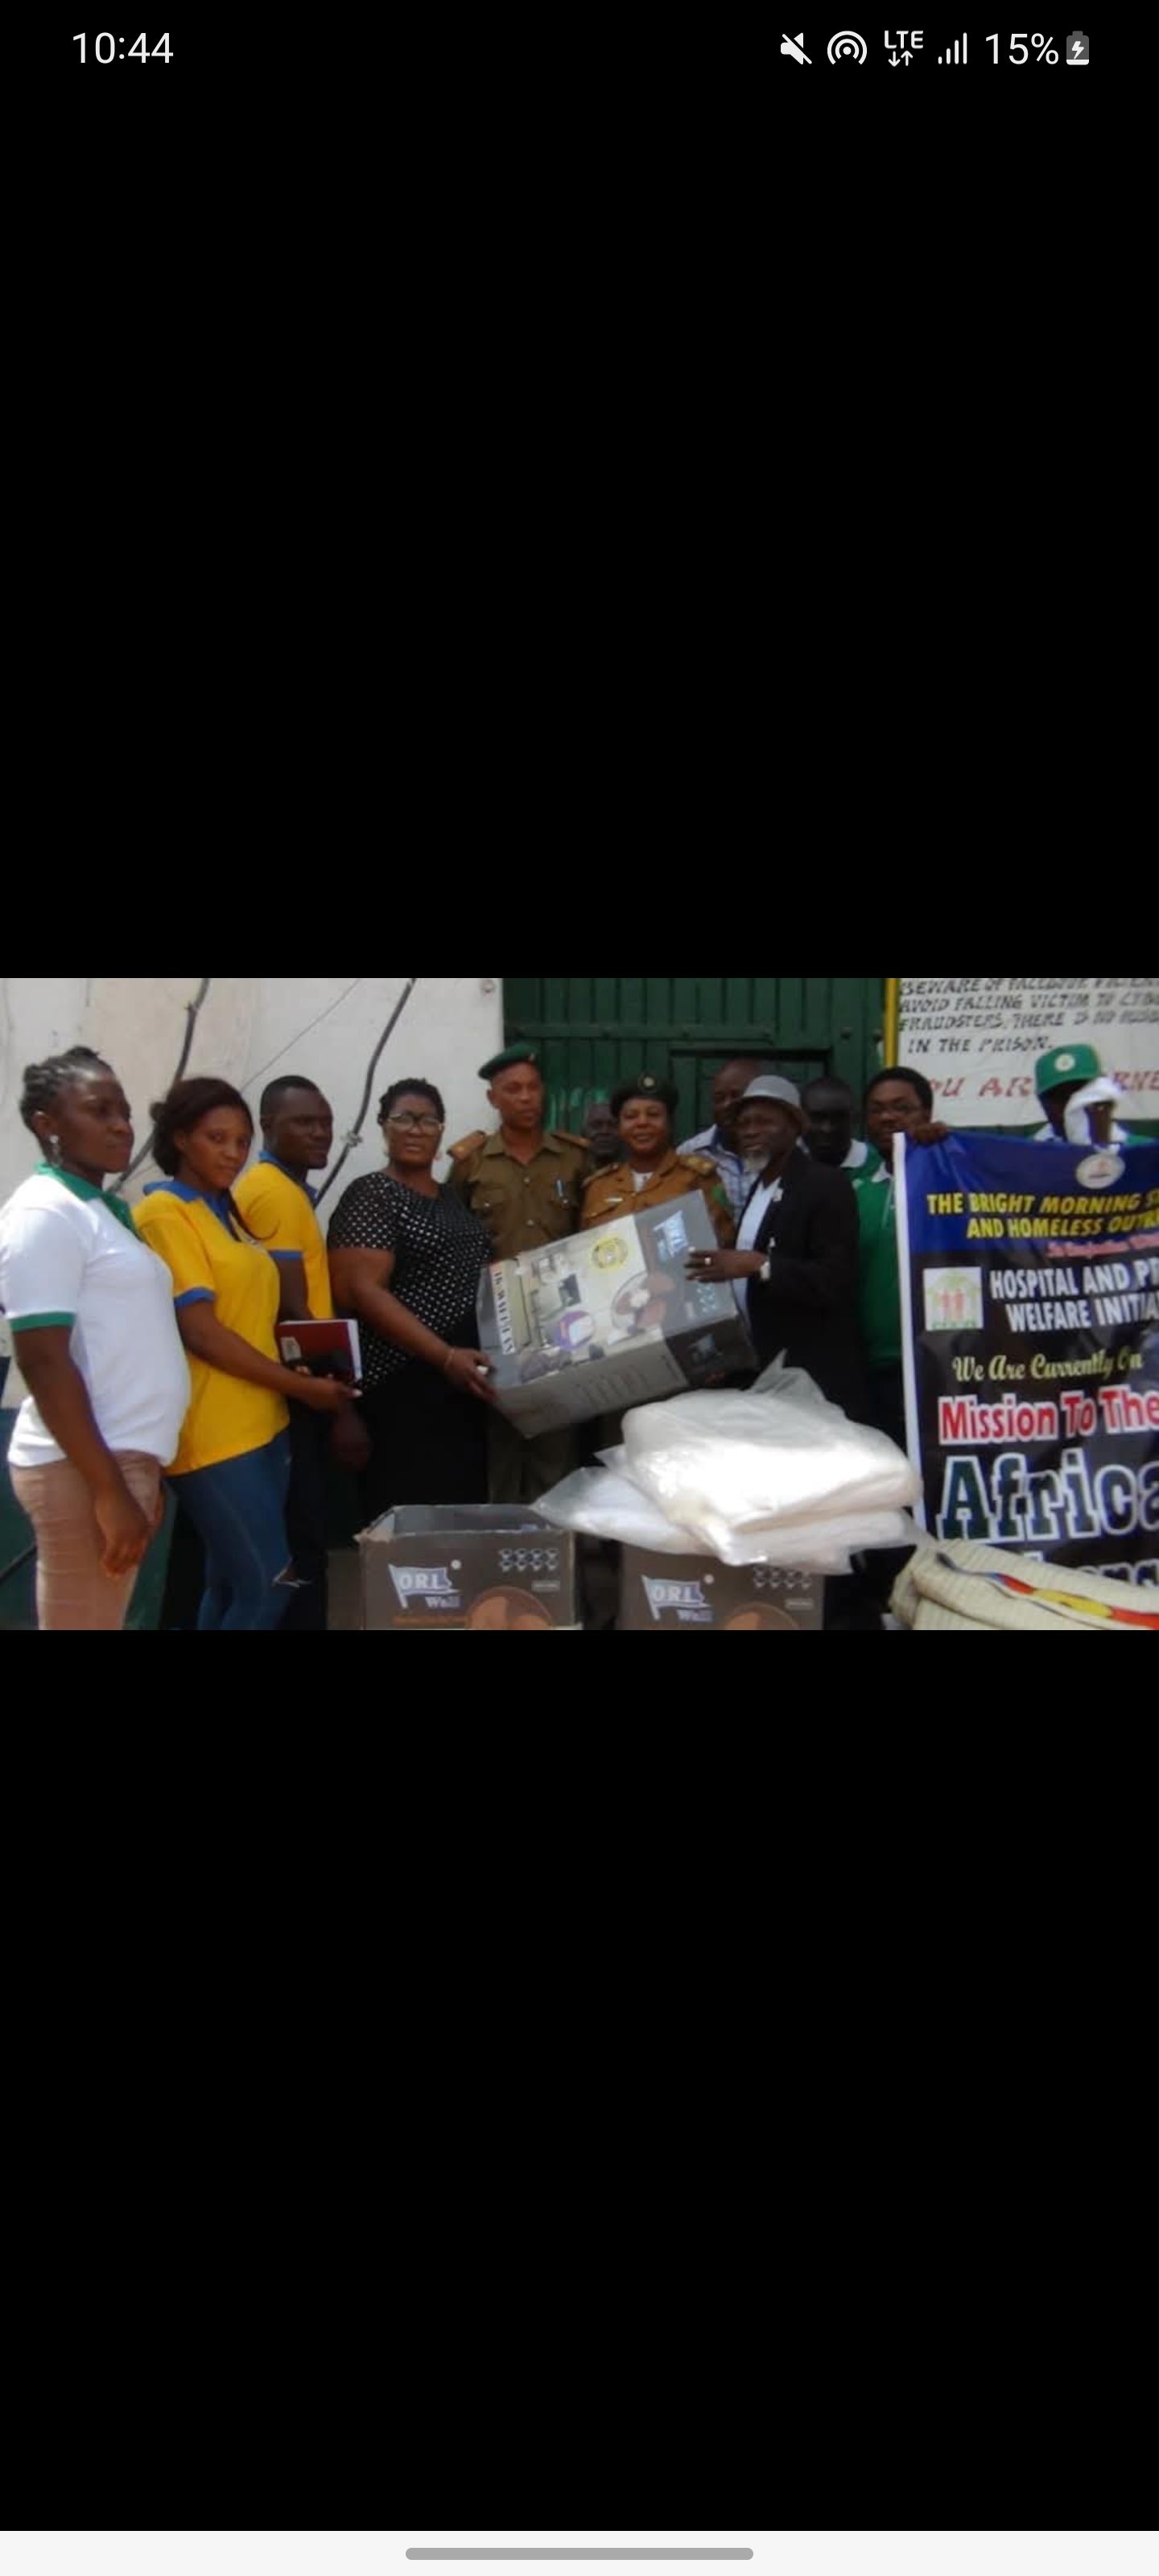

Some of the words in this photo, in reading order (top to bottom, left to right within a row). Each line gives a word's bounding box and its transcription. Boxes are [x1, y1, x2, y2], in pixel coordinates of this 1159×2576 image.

[899, 997, 951, 1013] AVOID
[954, 993, 1024, 1011] FALLING
[1013, 1012, 1065, 1030] THERE
[908, 1038, 932, 1054] IN
[938, 1038, 971, 1053] THE
[926, 1193, 964, 1215] THE
[967, 1193, 1036, 1214] BRIGHT
[1038, 1192, 1141, 1215] MORNING
[967, 1218, 1004, 1239] AND
[1008, 1216, 1103, 1239] HOMELESS
[989, 1266, 1079, 1300] HOSPITAL
[1082, 1262, 1131, 1295] AND
[1004, 1298, 1092, 1333] WELFARE
[951, 1355, 985, 1382] We
[988, 1354, 1026, 1381] Are
[1030, 1348, 1114, 1381] Currently
[1116, 1347, 1145, 1370] On
[938, 1393, 1059, 1447] Mission
[1060, 1389, 1097, 1439] To
[1098, 1383, 1159, 1435] The
[400, 1572, 442, 1591] ORL
[653, 1584, 695, 1603] ORL
